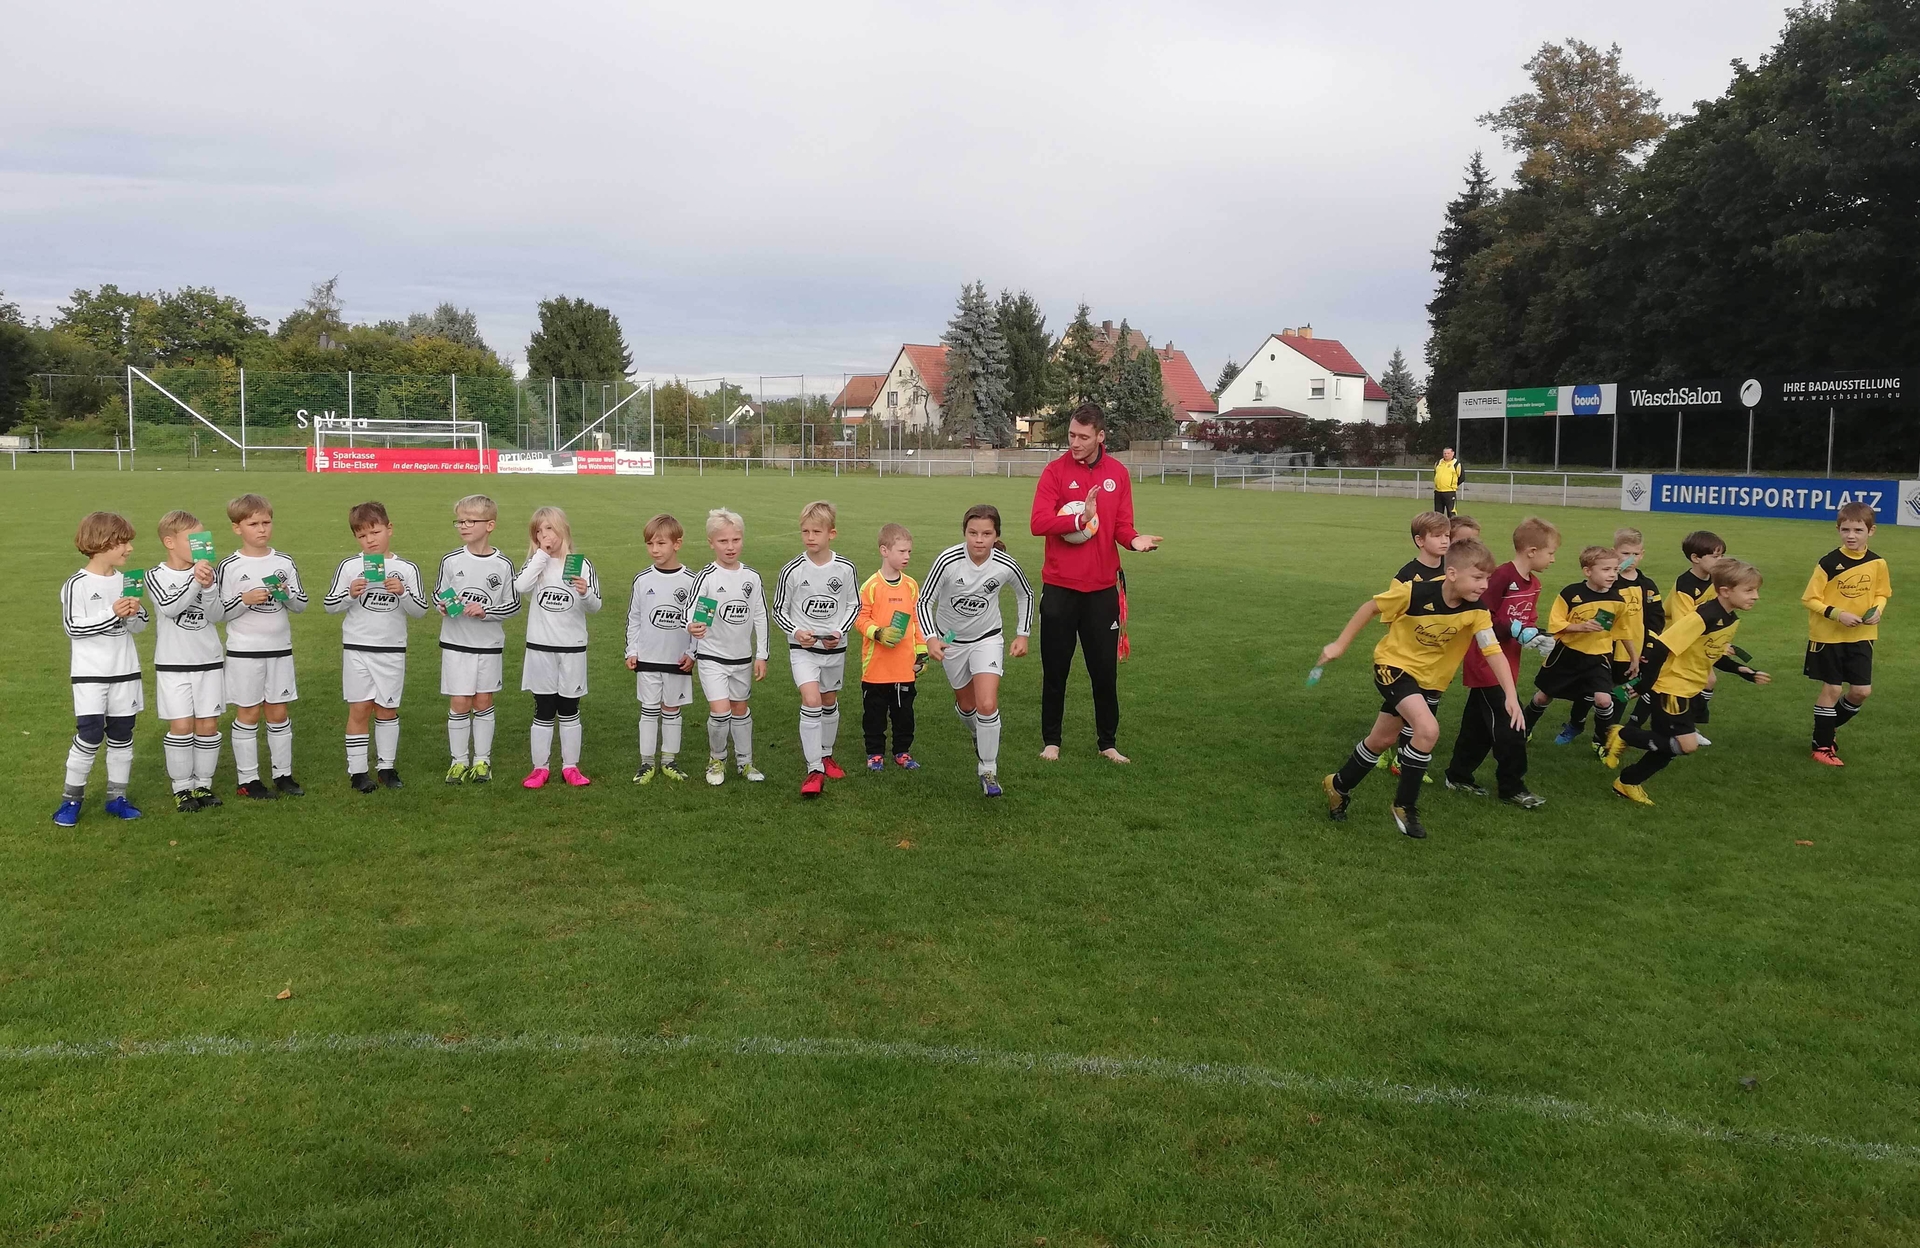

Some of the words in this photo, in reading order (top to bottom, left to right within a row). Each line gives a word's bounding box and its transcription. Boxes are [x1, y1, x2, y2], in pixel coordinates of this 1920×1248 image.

[1783, 382, 1806, 393] IHRE
[1808, 378, 1901, 392] BADAUSSTELLUNG
[1463, 397, 1503, 406] RENTABEL
[1574, 393, 1600, 406] bauch
[1630, 387, 1723, 407] WaschSalon
[1783, 392, 1901, 402] www.waschsalon.eu
[333, 451, 376, 461] Sparkasse
[499, 452, 544, 462] OPTICARD
[333, 461, 379, 469] Elbe-Elster
[414, 462, 440, 471] Region.
[1661, 484, 1884, 513] EINHEITSPORTPLATZ
[362, 592, 396, 607] Fiwa
[539, 591, 570, 606] Fiwa
[953, 598, 986, 608] Fiwa
[805, 600, 836, 614] Fiwa
[652, 610, 682, 624] Fiwa
